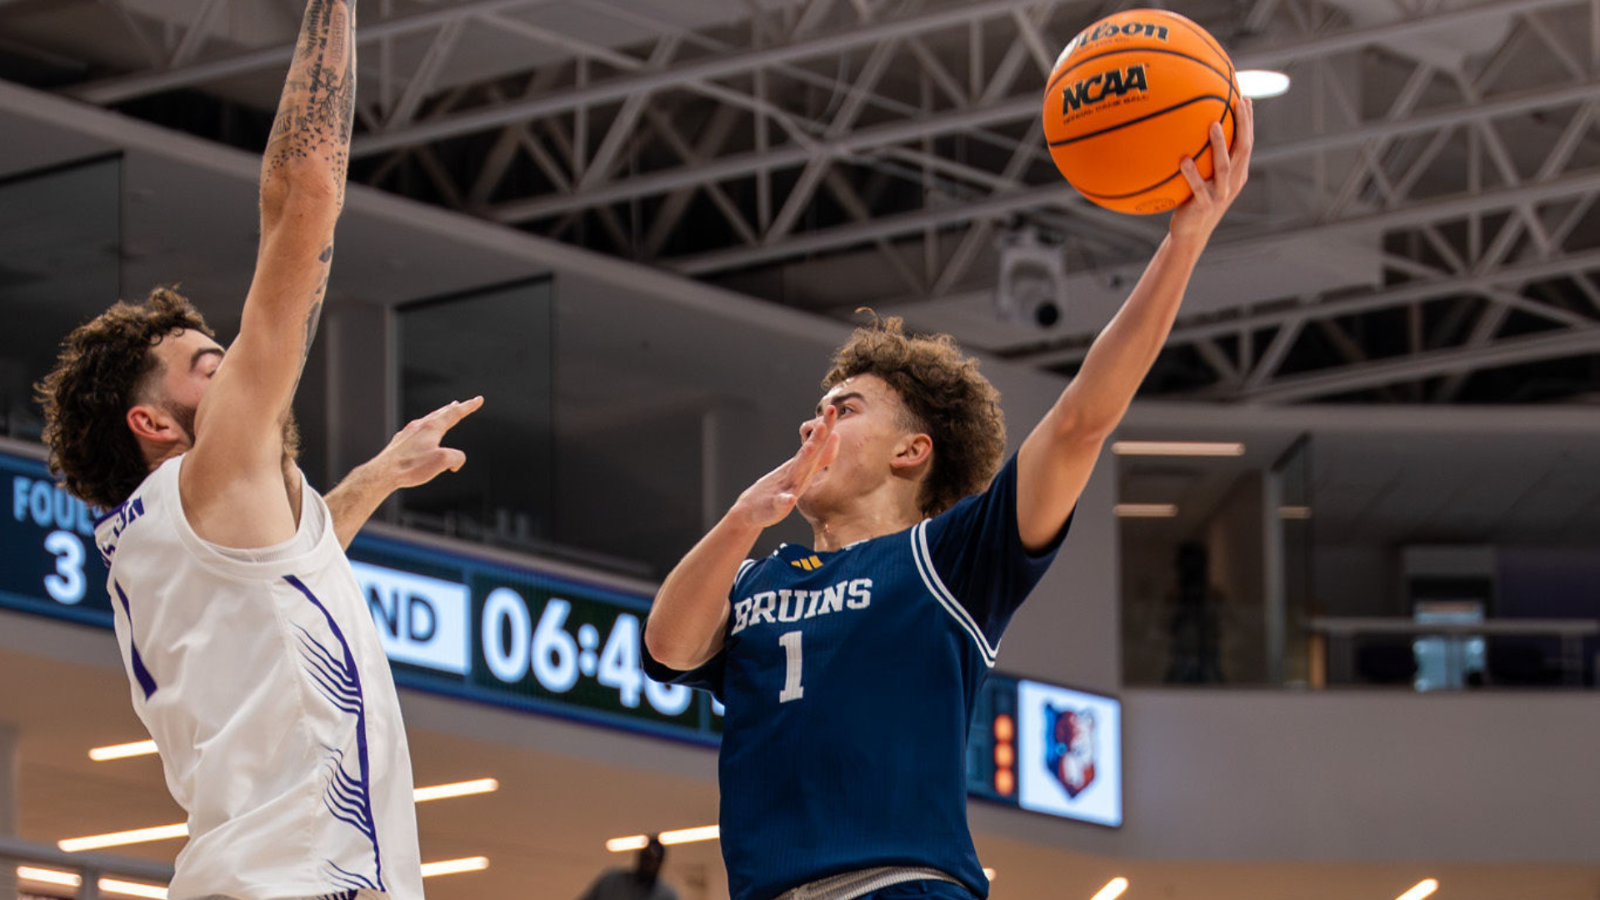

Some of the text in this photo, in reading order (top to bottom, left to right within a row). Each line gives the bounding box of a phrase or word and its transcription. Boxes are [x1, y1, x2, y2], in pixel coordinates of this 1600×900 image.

[1062, 64, 1148, 115] NCAA
[13, 476, 104, 537] FOUL
[44, 530, 87, 605] 3
[731, 578, 873, 636] BRUINS
[778, 630, 804, 703] 1
